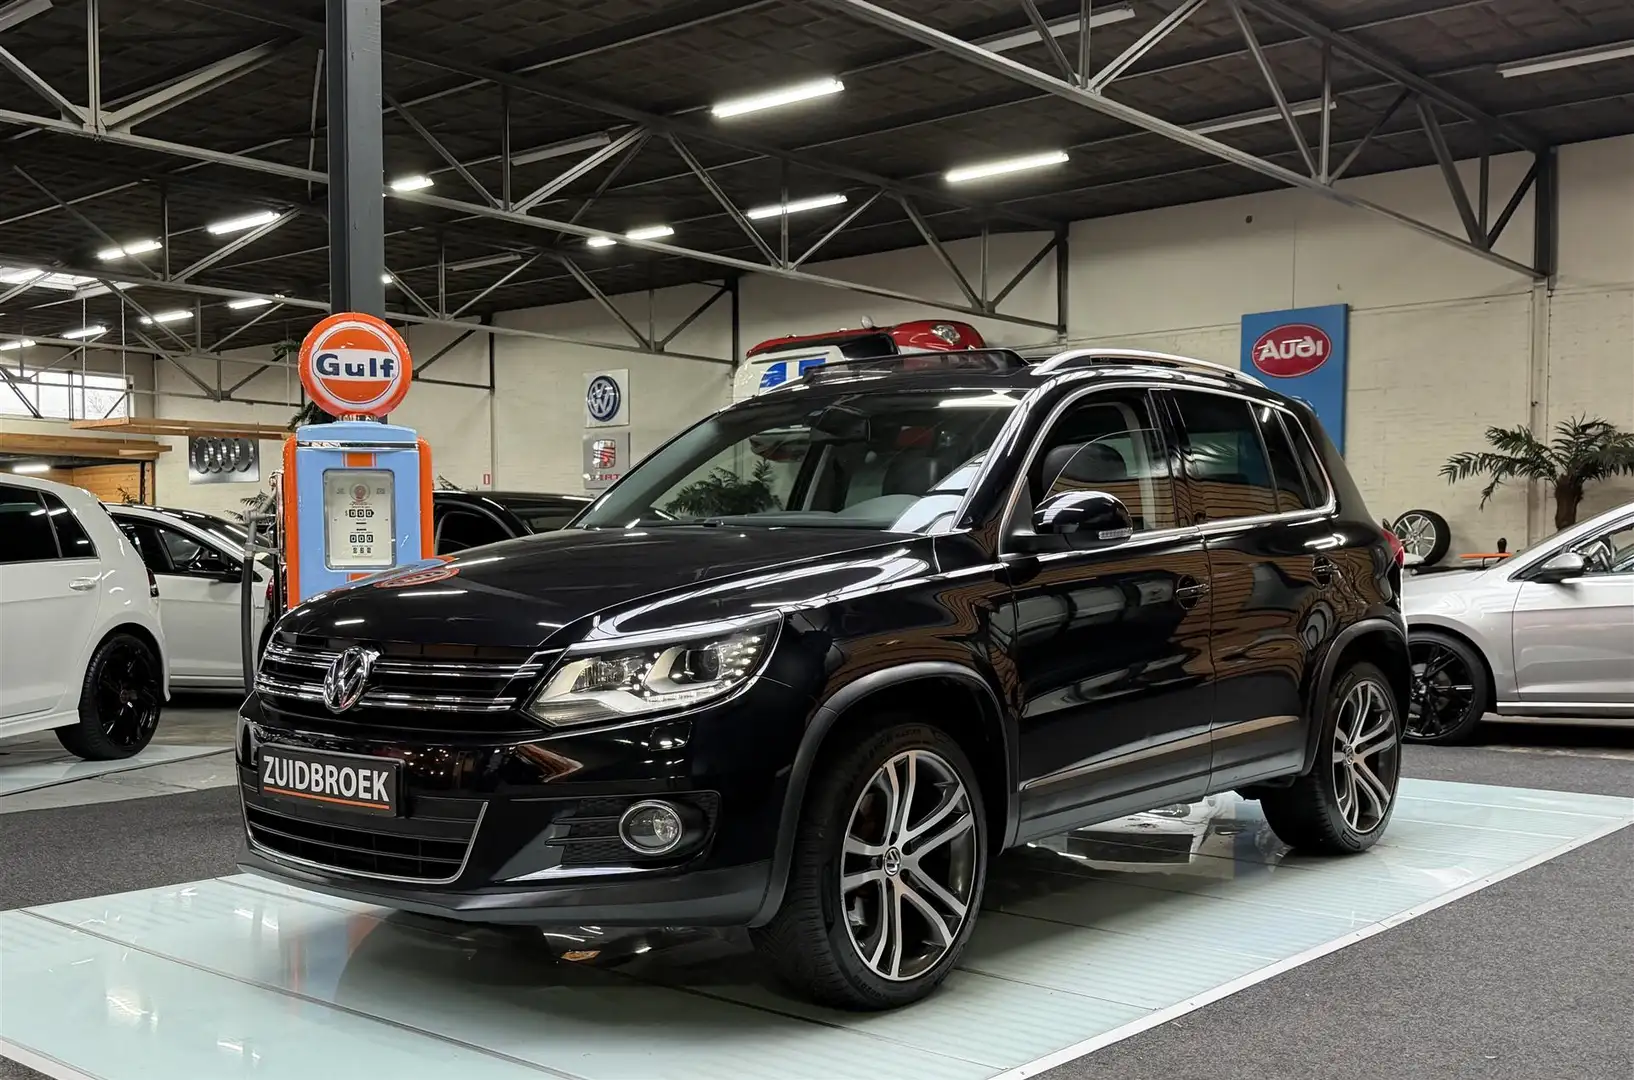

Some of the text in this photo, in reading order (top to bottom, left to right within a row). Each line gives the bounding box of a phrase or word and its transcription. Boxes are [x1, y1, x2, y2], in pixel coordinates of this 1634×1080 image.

[1259, 336, 1323, 361] Audi
[316, 353, 394, 378] Gulf
[263, 755, 390, 802] ZUIDBROEK
